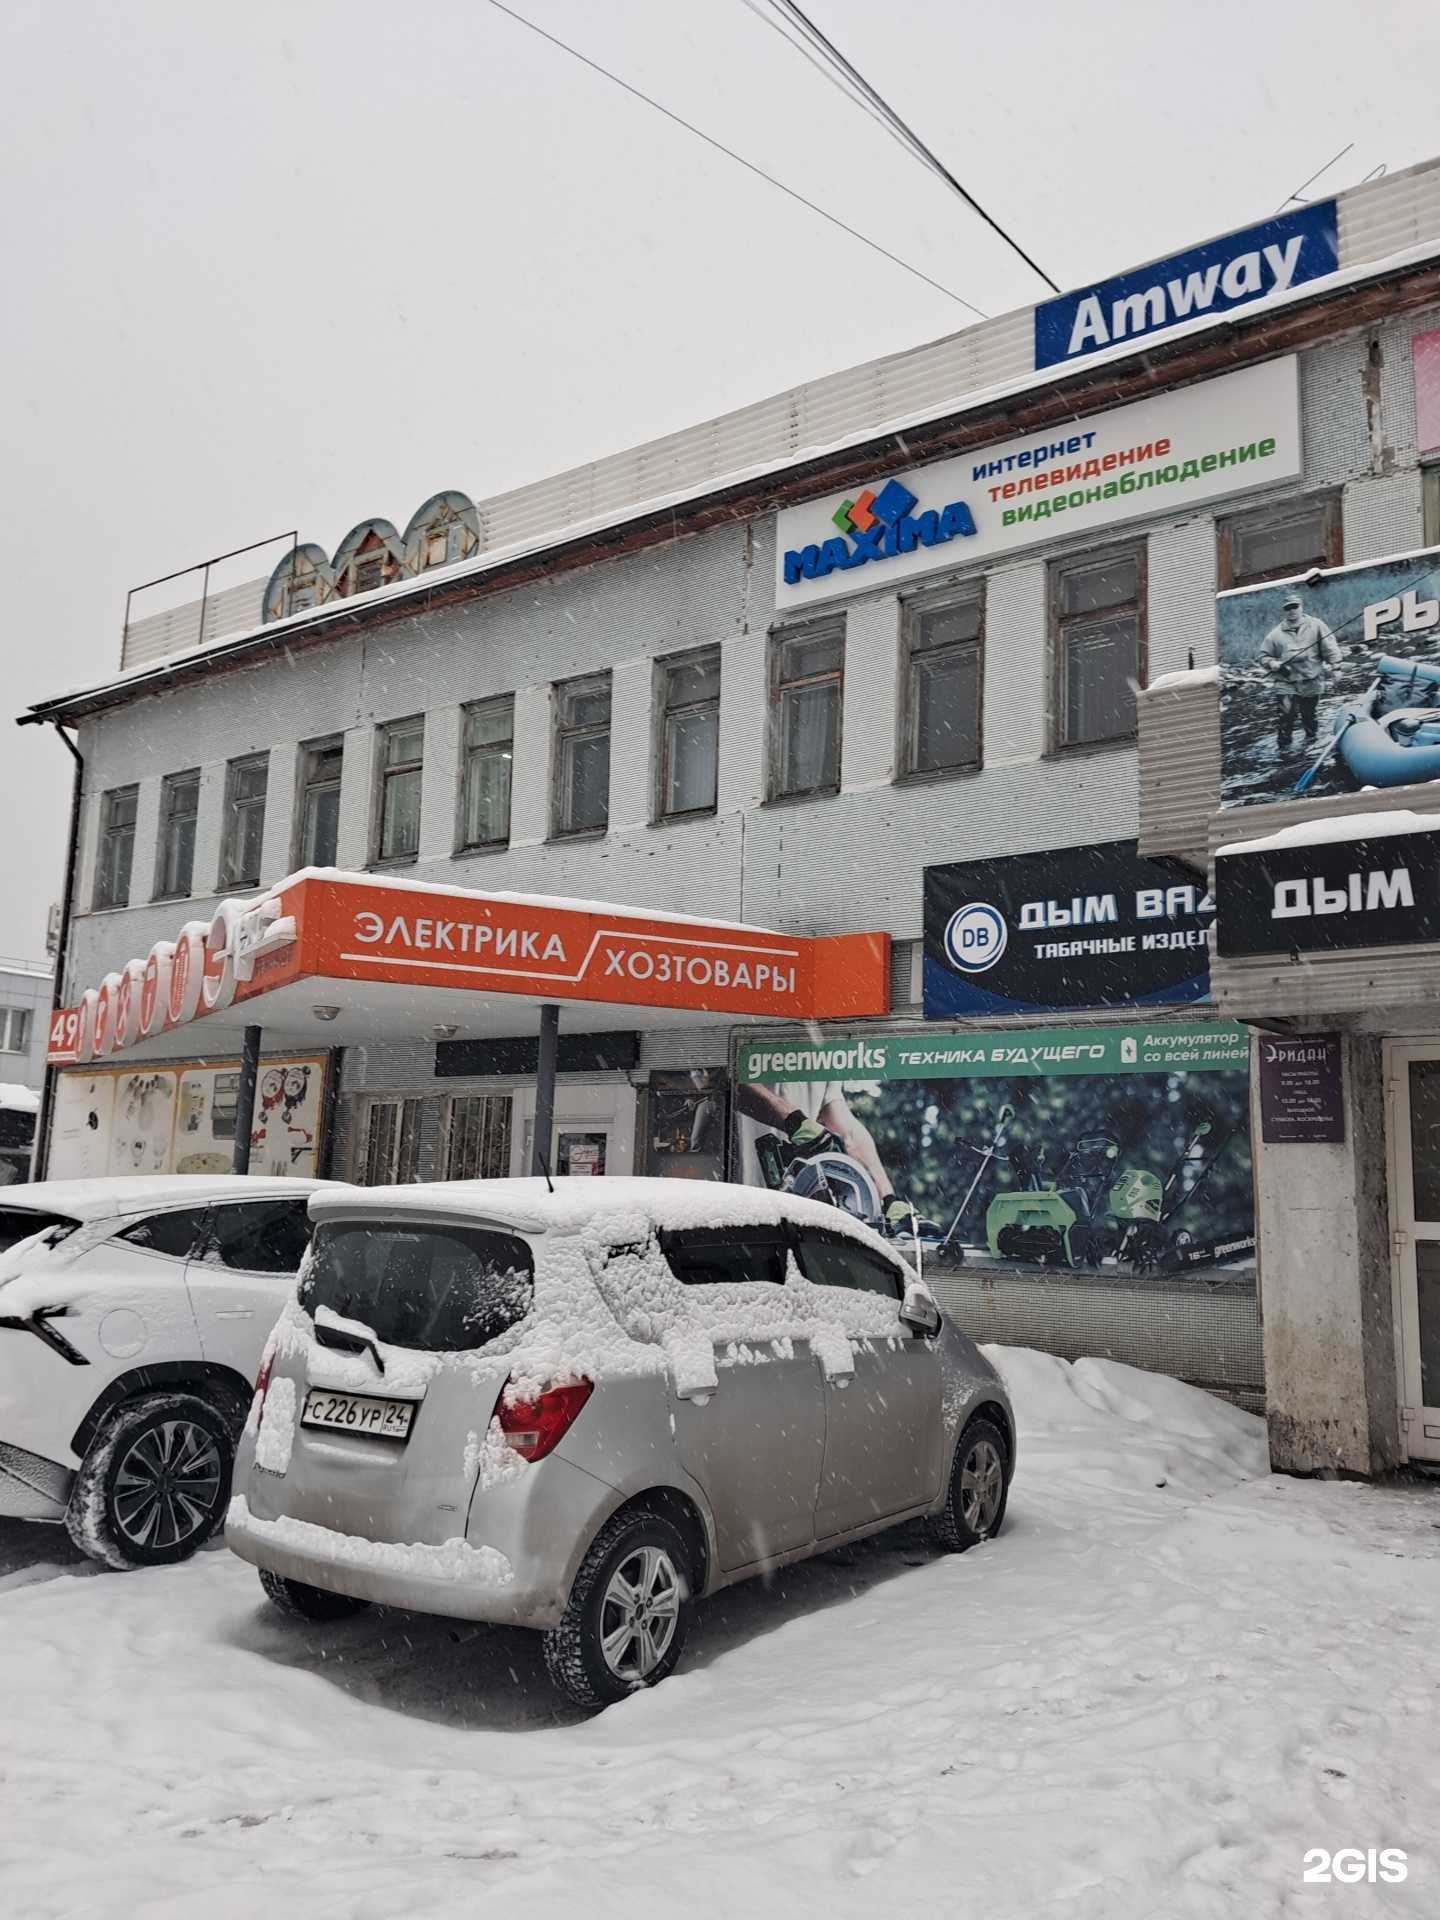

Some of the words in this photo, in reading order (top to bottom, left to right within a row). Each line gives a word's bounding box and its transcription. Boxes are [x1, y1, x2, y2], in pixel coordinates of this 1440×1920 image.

[1067, 235, 1303, 354] Amway
[972, 431, 1096, 481] интернет
[988, 438, 1171, 502] телевидение
[1002, 437, 1276, 527] видеонаблюдение
[784, 501, 977, 585] MAXIMA
[1018, 894, 1119, 930] ДЫМ
[1271, 868, 1416, 919] ДЫМ
[353, 911, 567, 963] ЭЛЕКТРИКА
[962, 927, 989, 948] DB
[1034, 935, 1137, 960] ТАБАЧНЫЕ
[604, 948, 796, 993] ХОЗТОВАРЫ
[749, 1042, 886, 1079] greenworks
[898, 1049, 986, 1065] ТЕХНИКА
[991, 1044, 1105, 1064] БУДУЩЕГО
[1143, 1033, 1239, 1048] Аккумулятор
[1143, 1051, 1161, 1063] со
[1165, 1048, 1199, 1062] всей
[386, 1405, 405, 1425] 24
